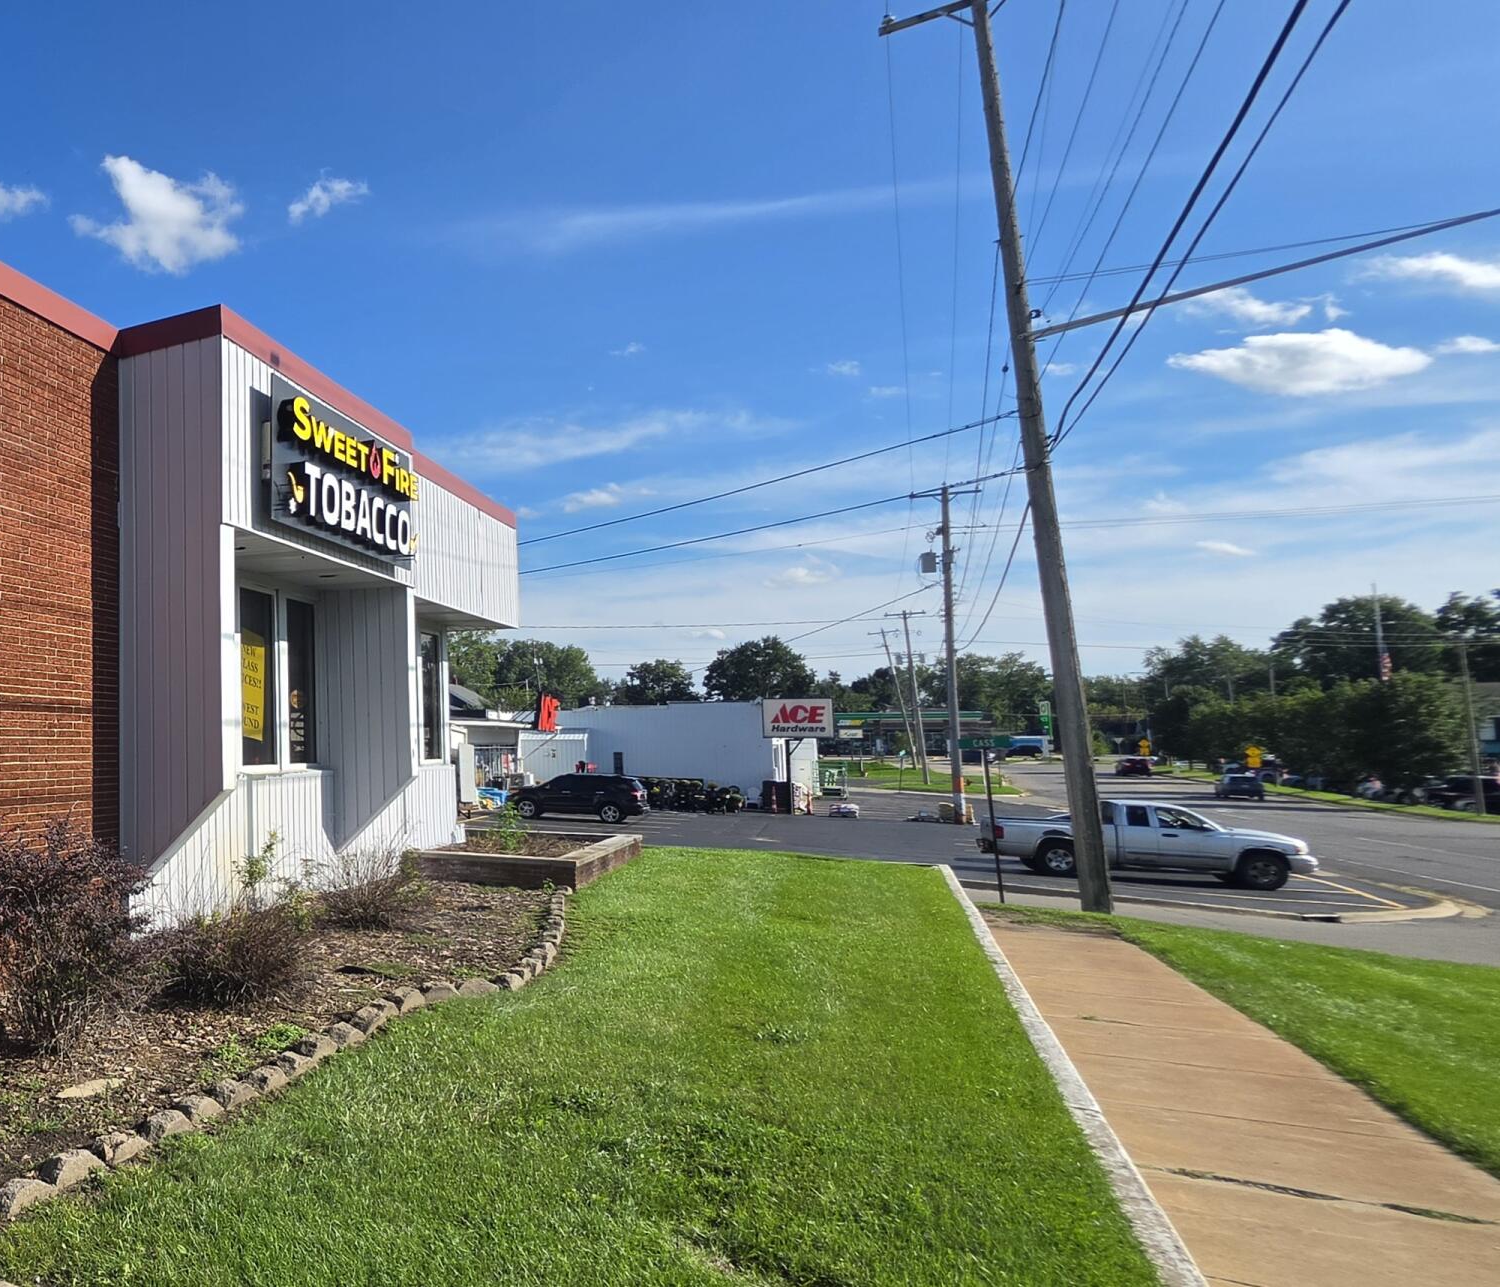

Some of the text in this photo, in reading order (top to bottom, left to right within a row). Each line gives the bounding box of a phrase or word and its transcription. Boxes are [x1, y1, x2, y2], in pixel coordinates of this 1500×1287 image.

[304, 461, 411, 556] TOBACCO
[771, 703, 826, 724] ACE
[771, 724, 827, 733] Hardware
[972, 738, 996, 748] CASS
